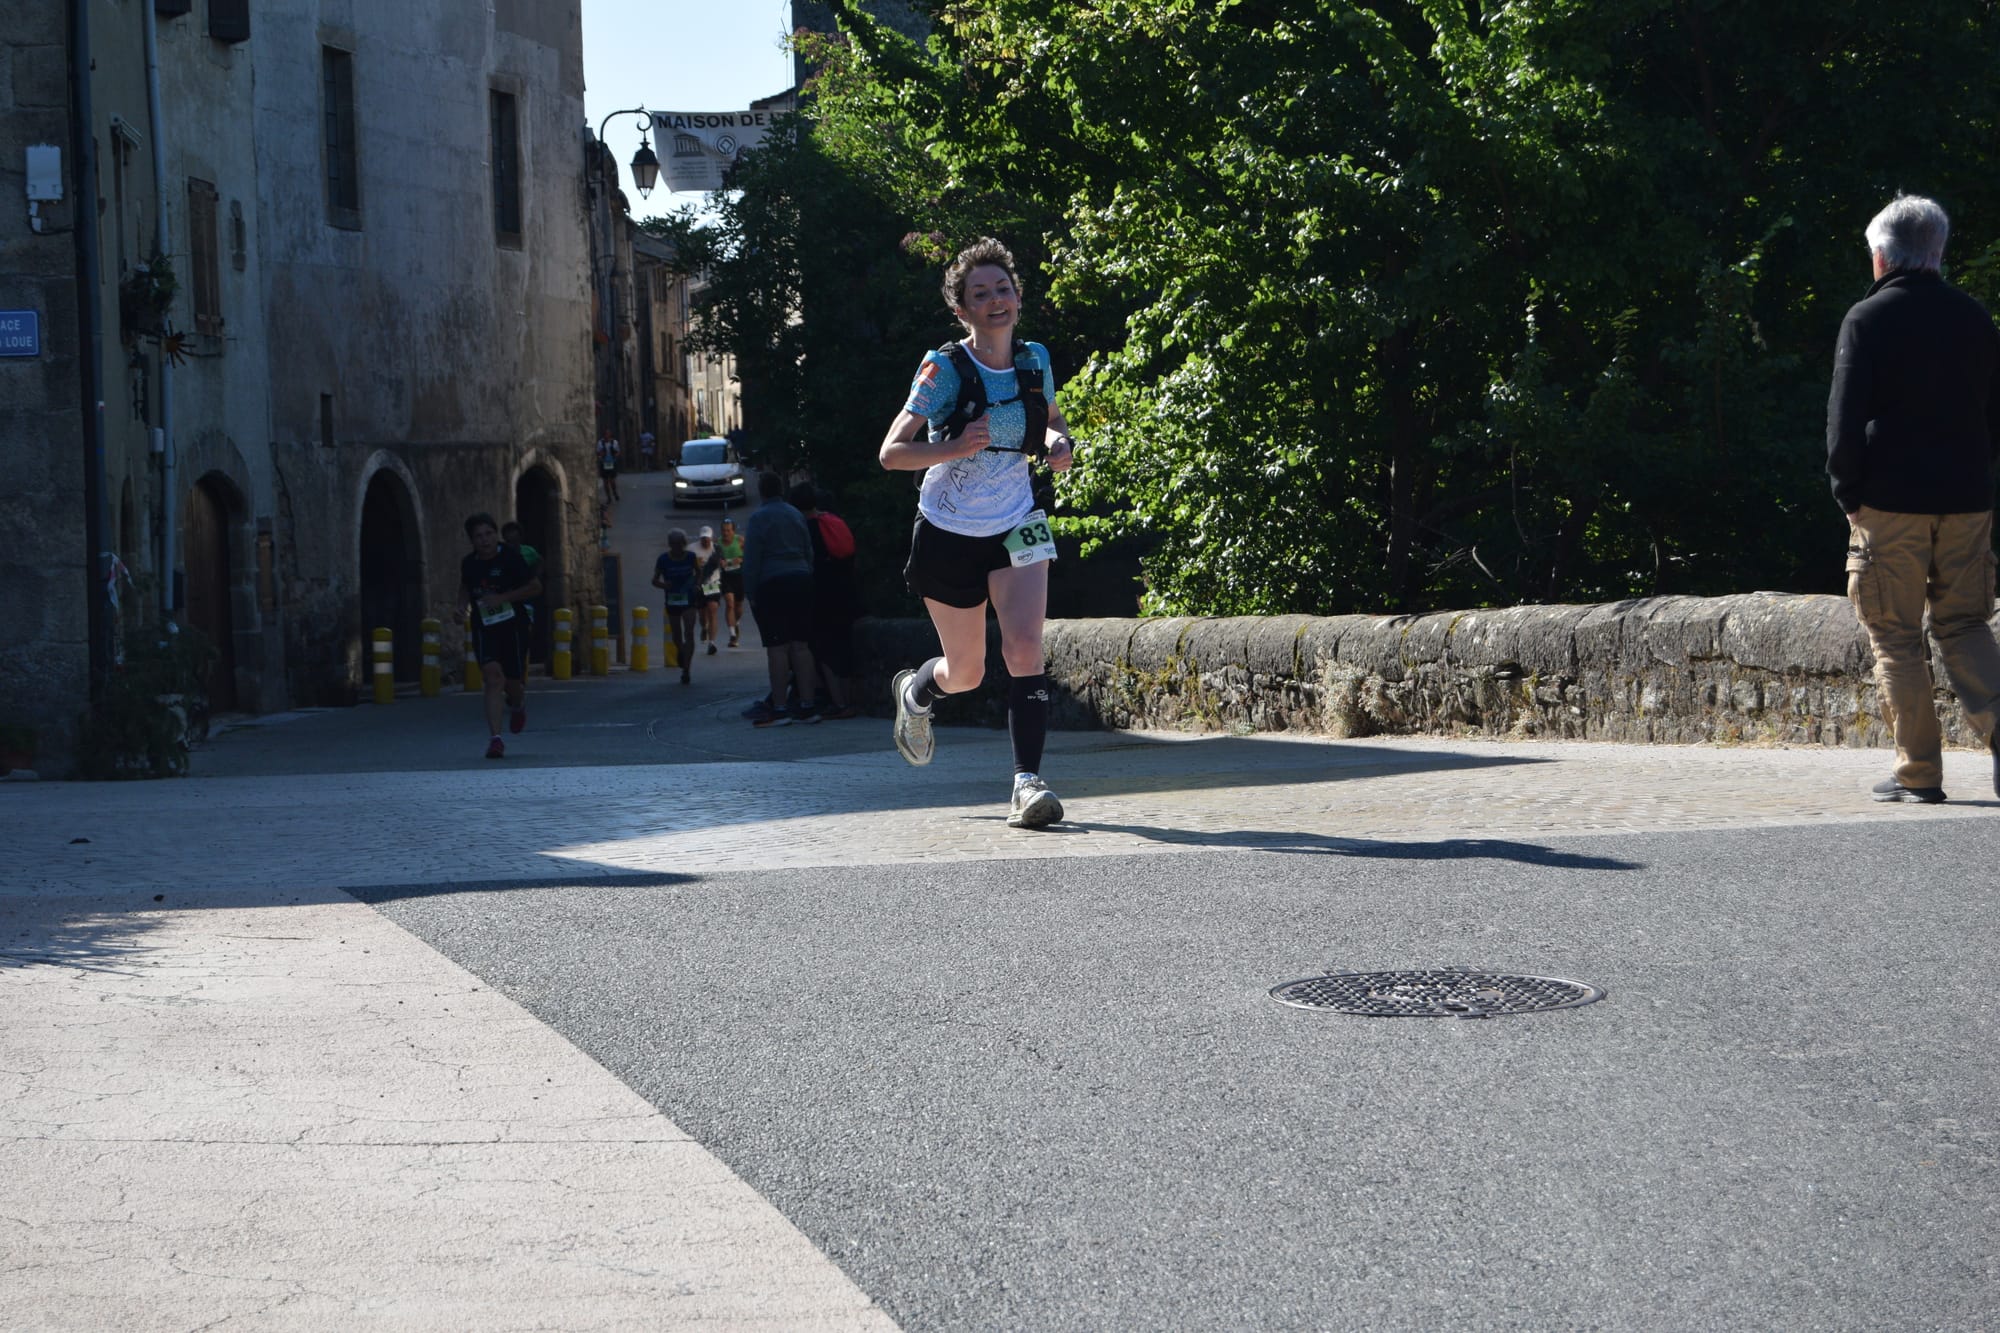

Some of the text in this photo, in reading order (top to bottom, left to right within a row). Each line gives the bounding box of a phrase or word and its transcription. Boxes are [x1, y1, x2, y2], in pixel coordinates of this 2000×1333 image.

[657, 114, 735, 129] MAISON
[740, 113, 765, 127] DE
[5, 336, 33, 348] LOUE
[1019, 523, 1050, 546] 83
